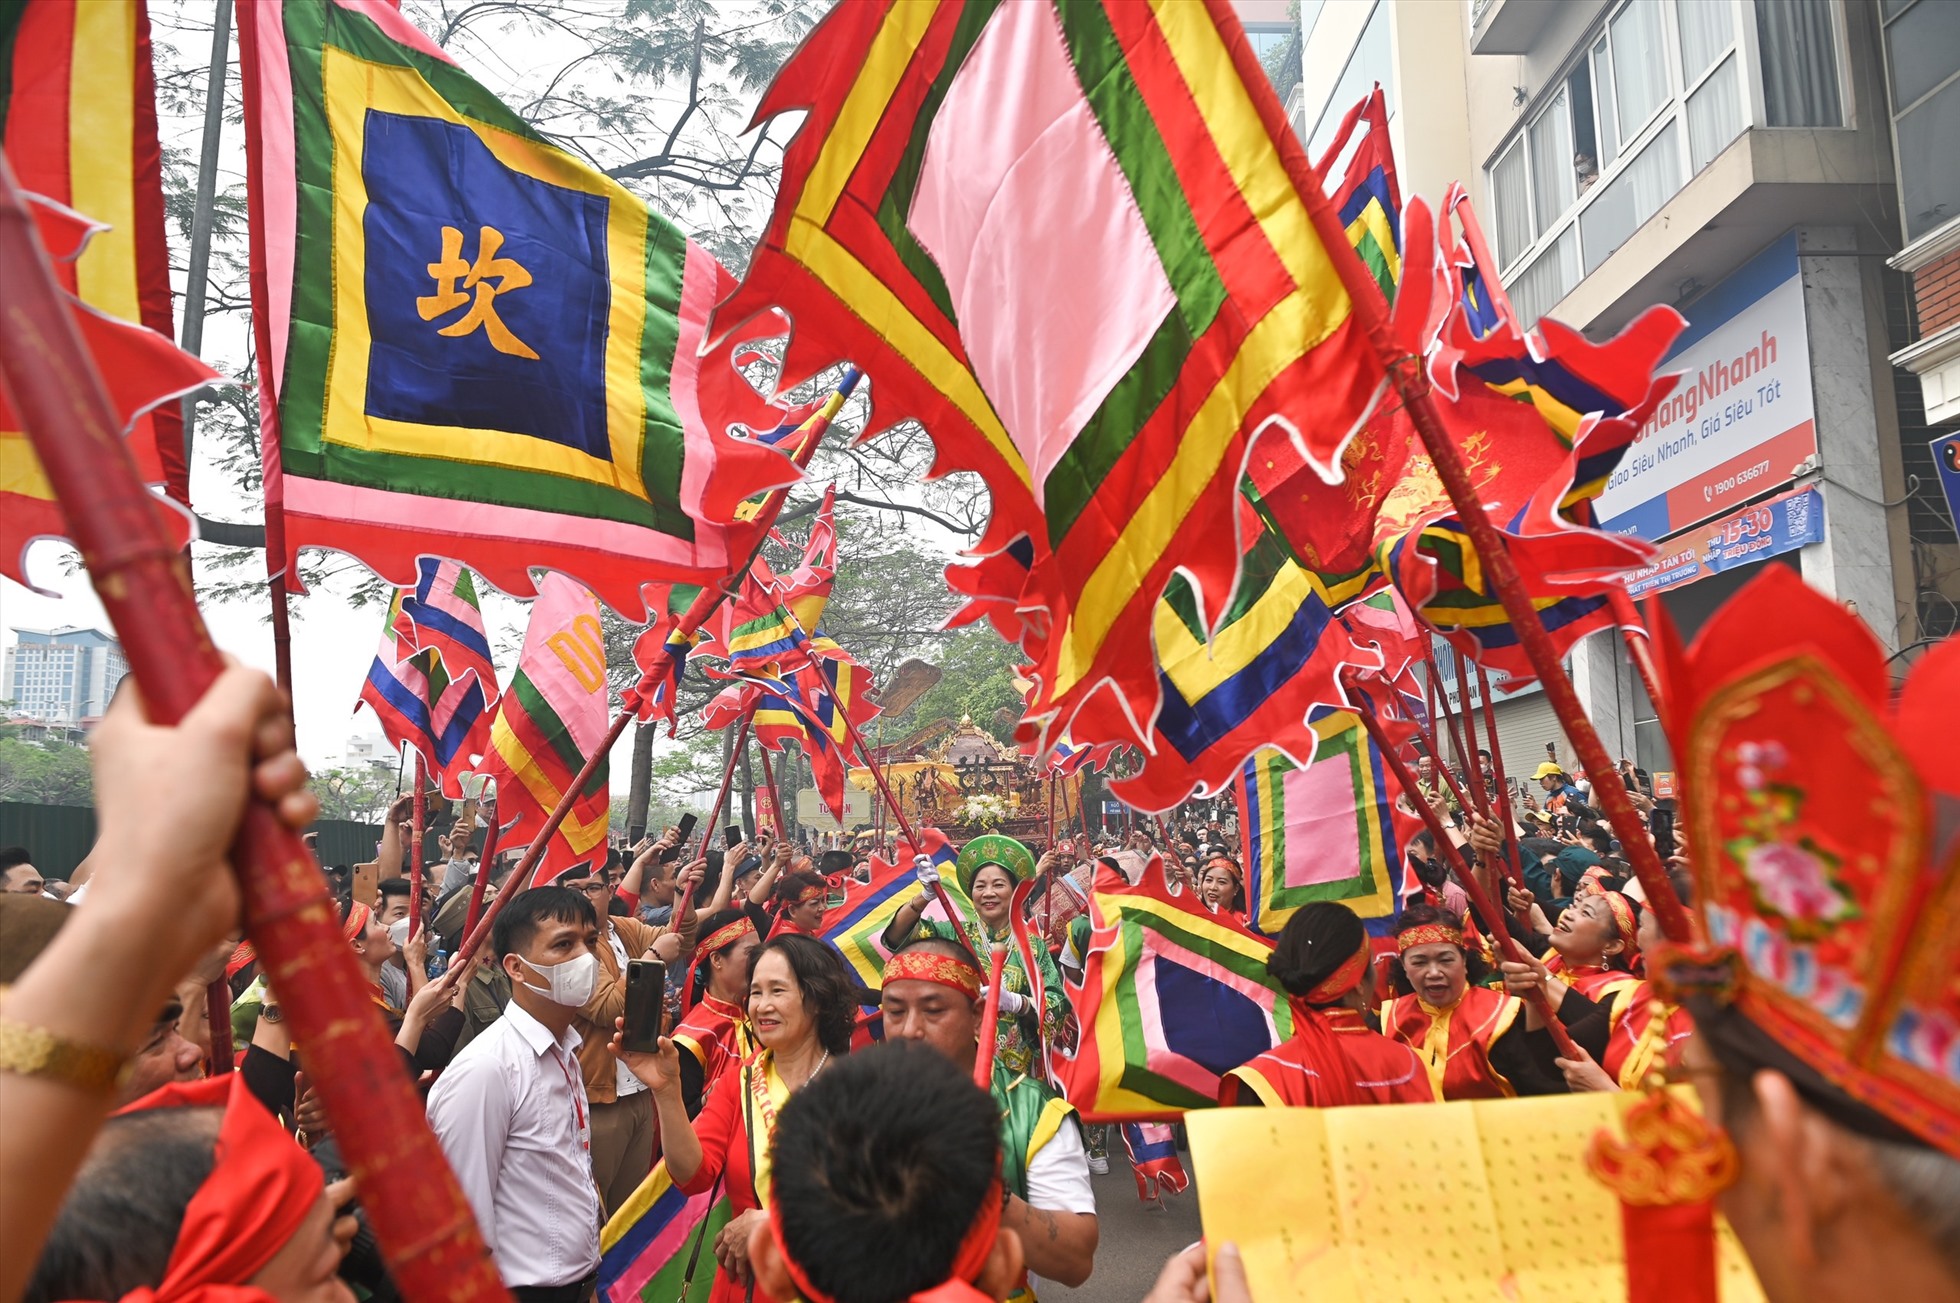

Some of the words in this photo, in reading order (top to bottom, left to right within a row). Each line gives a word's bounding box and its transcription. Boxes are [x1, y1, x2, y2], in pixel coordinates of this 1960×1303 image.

[416, 225, 540, 360] 坎
[1607, 468, 1629, 490] Giao
[1632, 454, 1654, 477] Siêu
[1657, 429, 1698, 464] Nhanh,
[1701, 410, 1721, 439] Giá
[1724, 399, 1753, 427] Siêu
[1757, 378, 1781, 408] Tốt
[1714, 477, 1735, 495] 1900
[1737, 459, 1770, 486] 636677
[1707, 535, 1721, 548] THU
[1722, 507, 1773, 546] 15-30
[1661, 554, 1679, 569] TẤN
[1680, 548, 1695, 563] TỚI
[1723, 543, 1748, 560] TRIỆU
[1748, 534, 1772, 552] ĐỒNG
